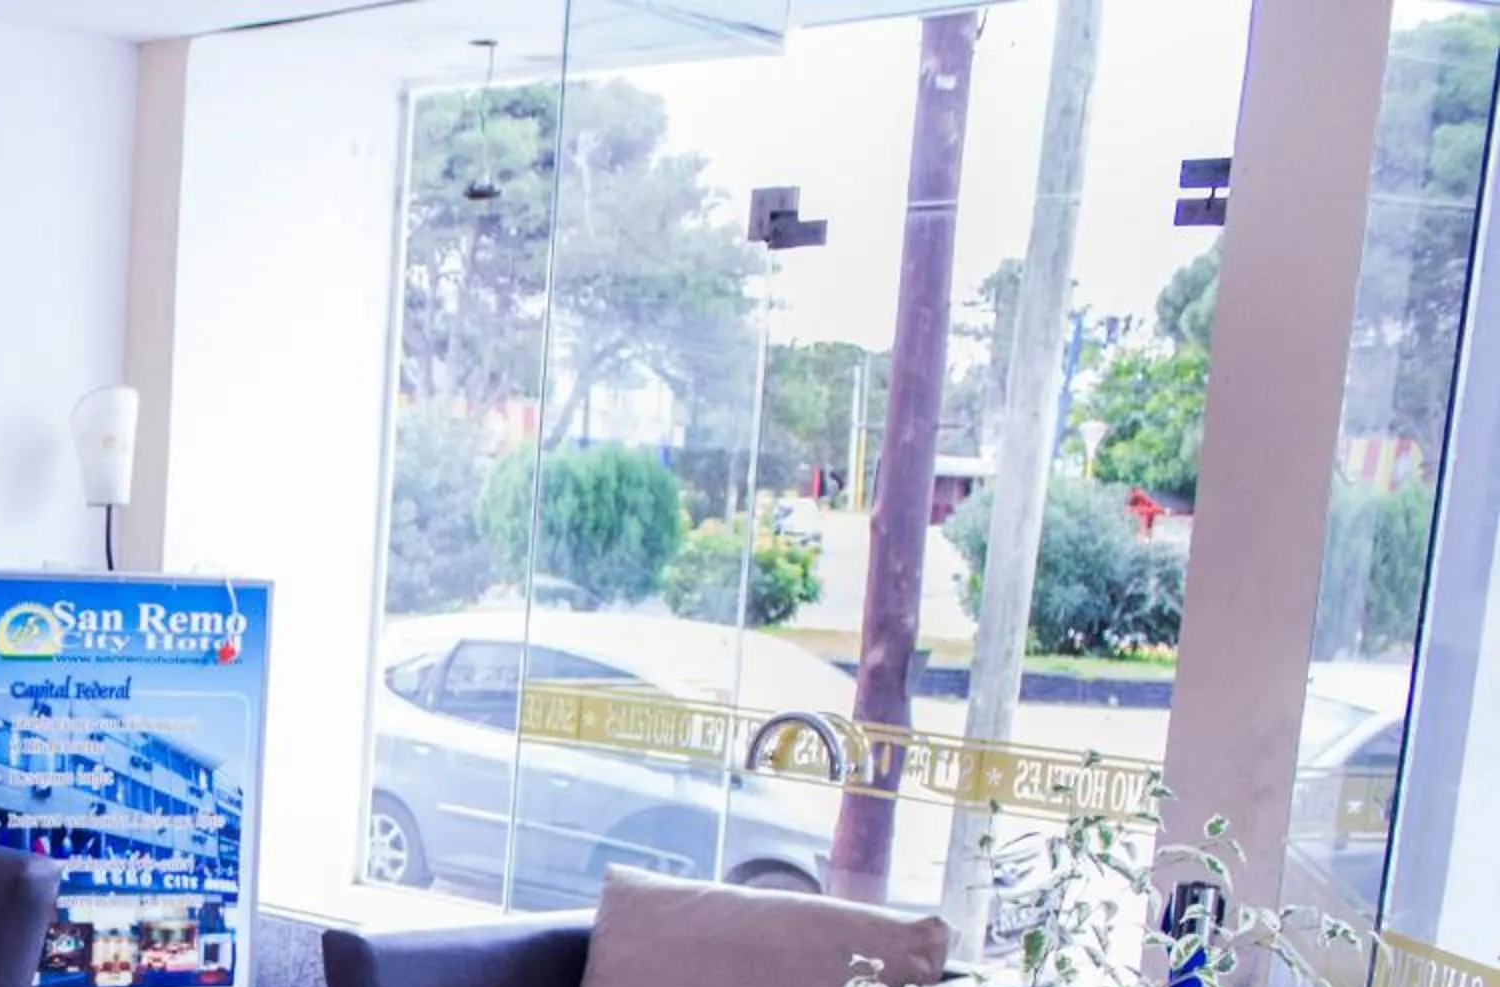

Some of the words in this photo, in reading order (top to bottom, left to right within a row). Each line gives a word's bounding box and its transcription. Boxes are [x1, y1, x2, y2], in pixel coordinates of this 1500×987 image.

[52, 600, 123, 632] San
[138, 603, 248, 635] Remo
[55, 631, 131, 653] City
[10, 675, 71, 703] Capital
[74, 675, 132, 700] Federal
